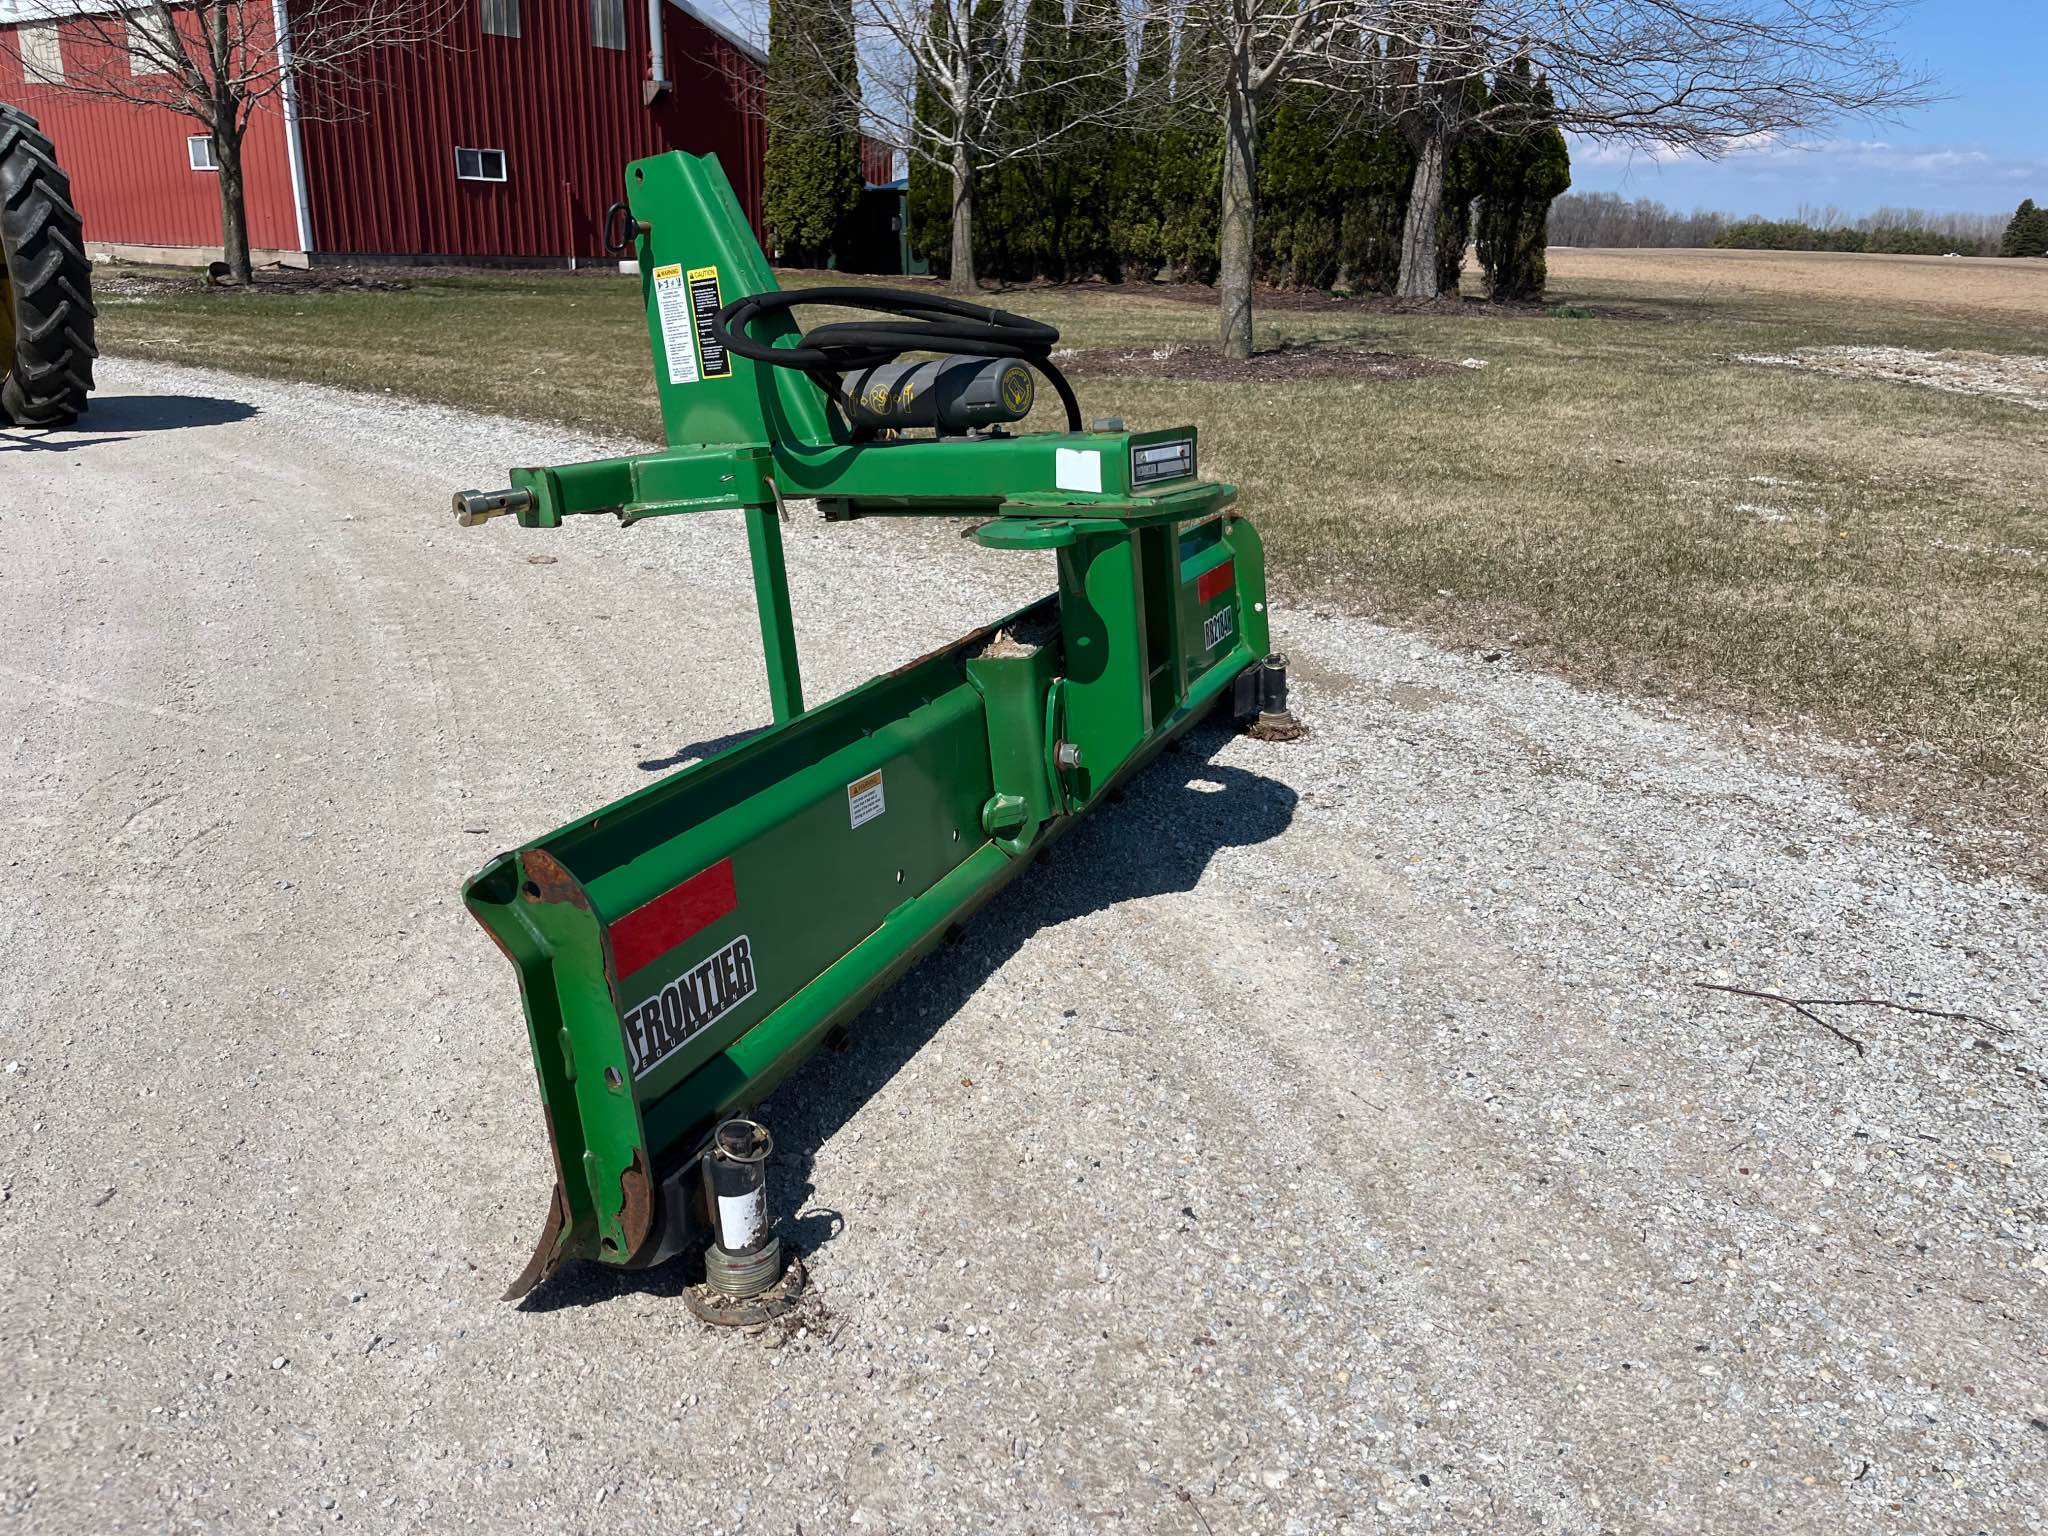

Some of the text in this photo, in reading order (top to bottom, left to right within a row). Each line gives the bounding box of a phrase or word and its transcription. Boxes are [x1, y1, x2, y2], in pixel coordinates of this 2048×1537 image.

[694, 270, 715, 279] CAUTION
[624, 938, 756, 1069] FRONTIER
[642, 984, 749, 1068] EQUIPMENT
